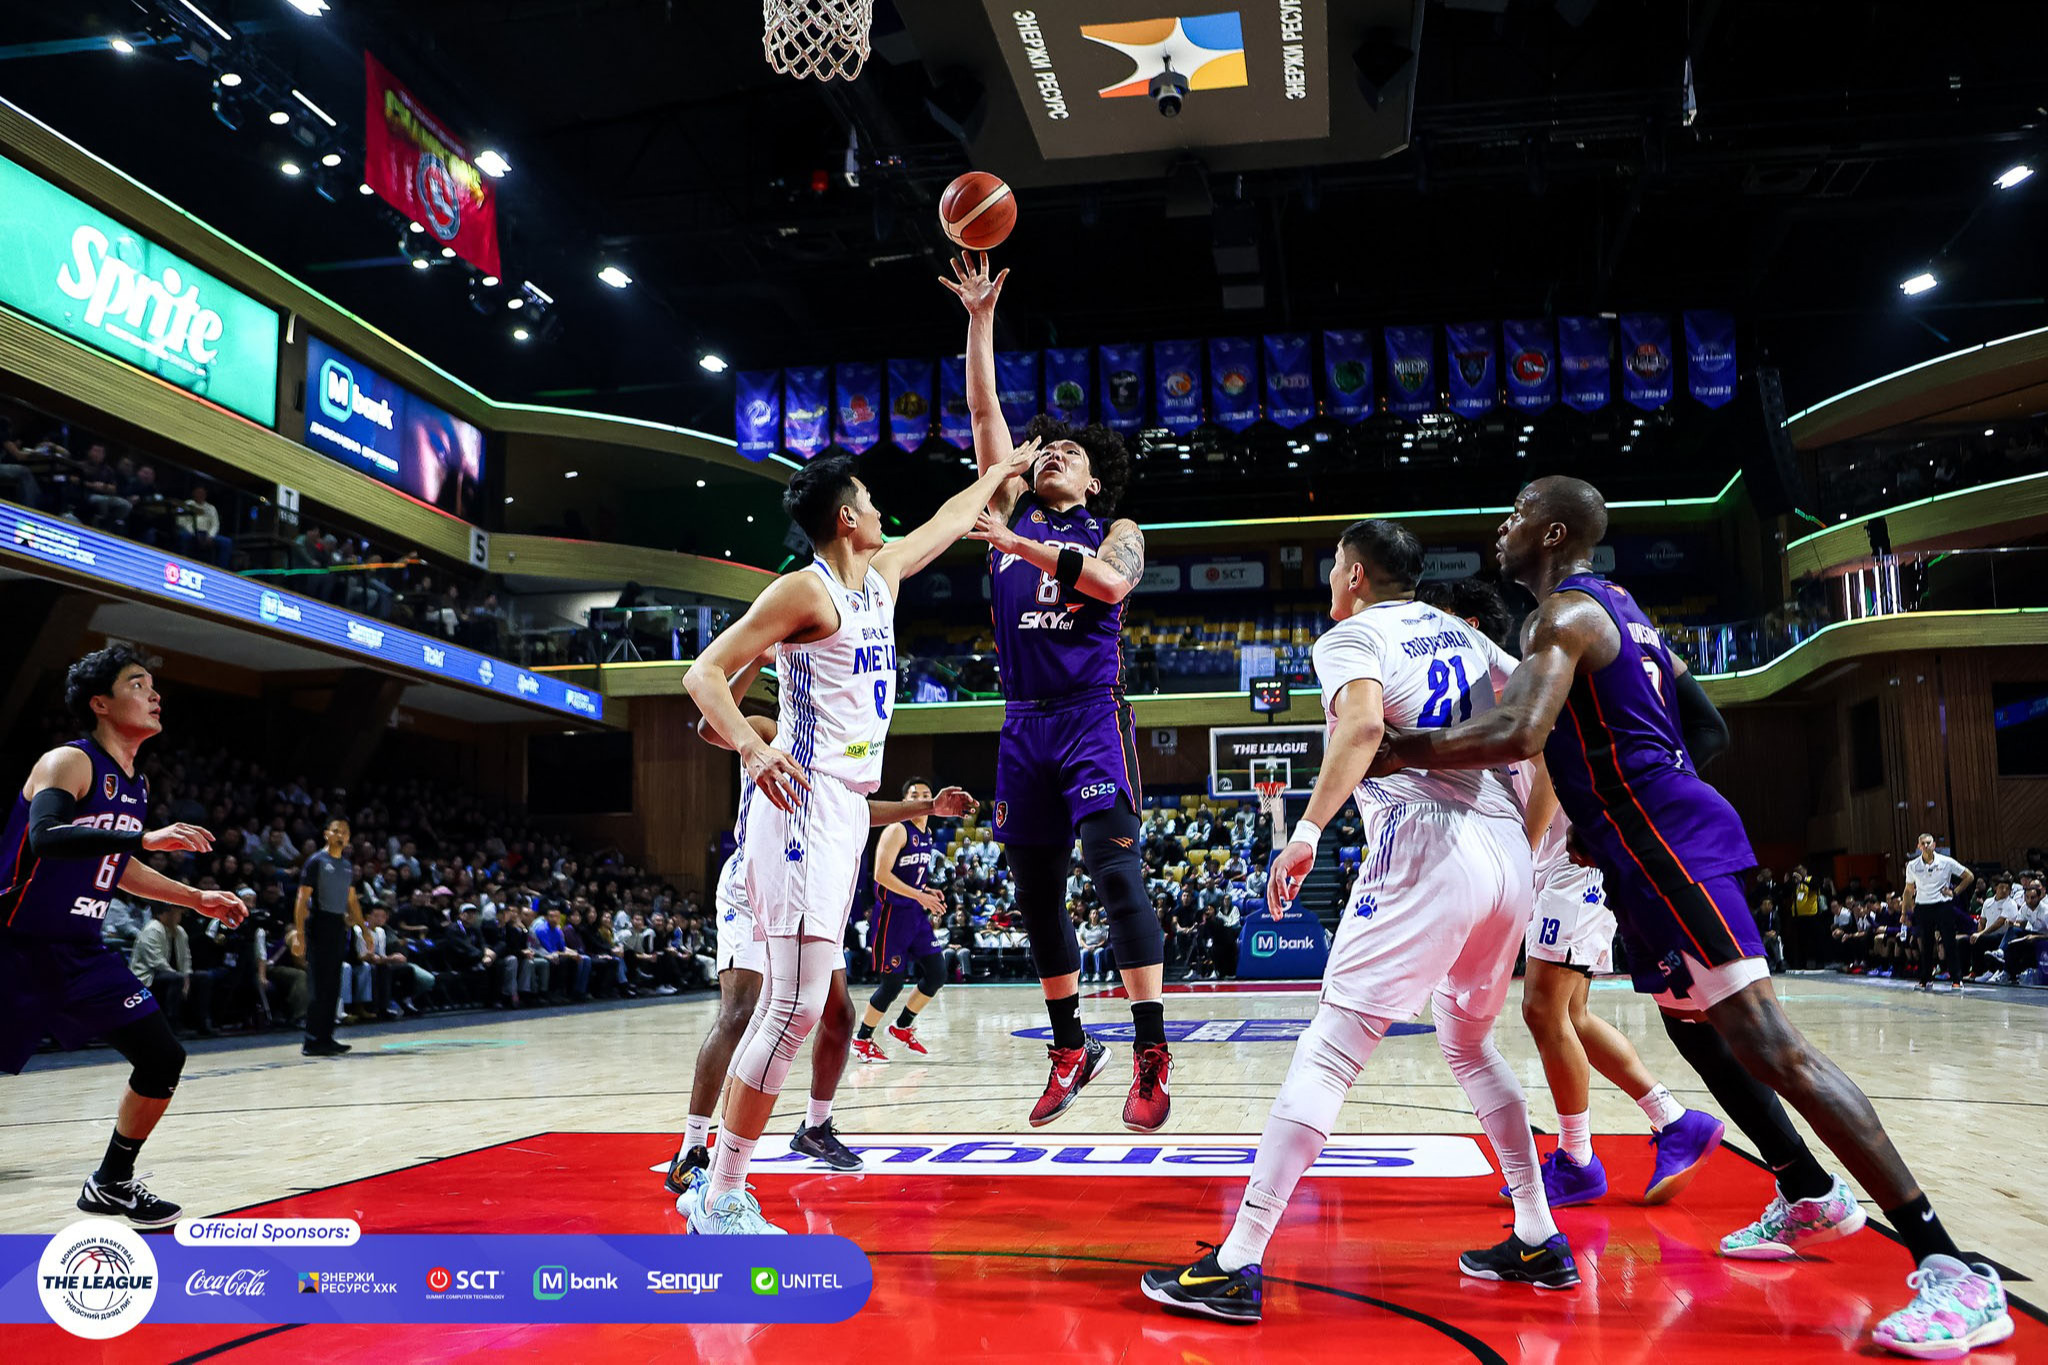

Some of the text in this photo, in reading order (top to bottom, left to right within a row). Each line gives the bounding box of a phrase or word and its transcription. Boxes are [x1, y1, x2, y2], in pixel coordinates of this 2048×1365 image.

[1012, 10, 1070, 120] ЭНЕРЖИ РЕСУРС
[1282, 44, 1307, 100] ЭНЕРЖИ
[56, 225, 224, 364] Sprite
[328, 370, 394, 430] M bank
[475, 532, 486, 562] 5
[1222, 568, 1247, 580] SCT
[1157, 730, 1171, 744] D
[1232, 741, 1309, 756] THE LEAGUE
[1080, 782, 1117, 800] GS25
[1258, 935, 1315, 950] M bank
[1538, 917, 1561, 945] 13
